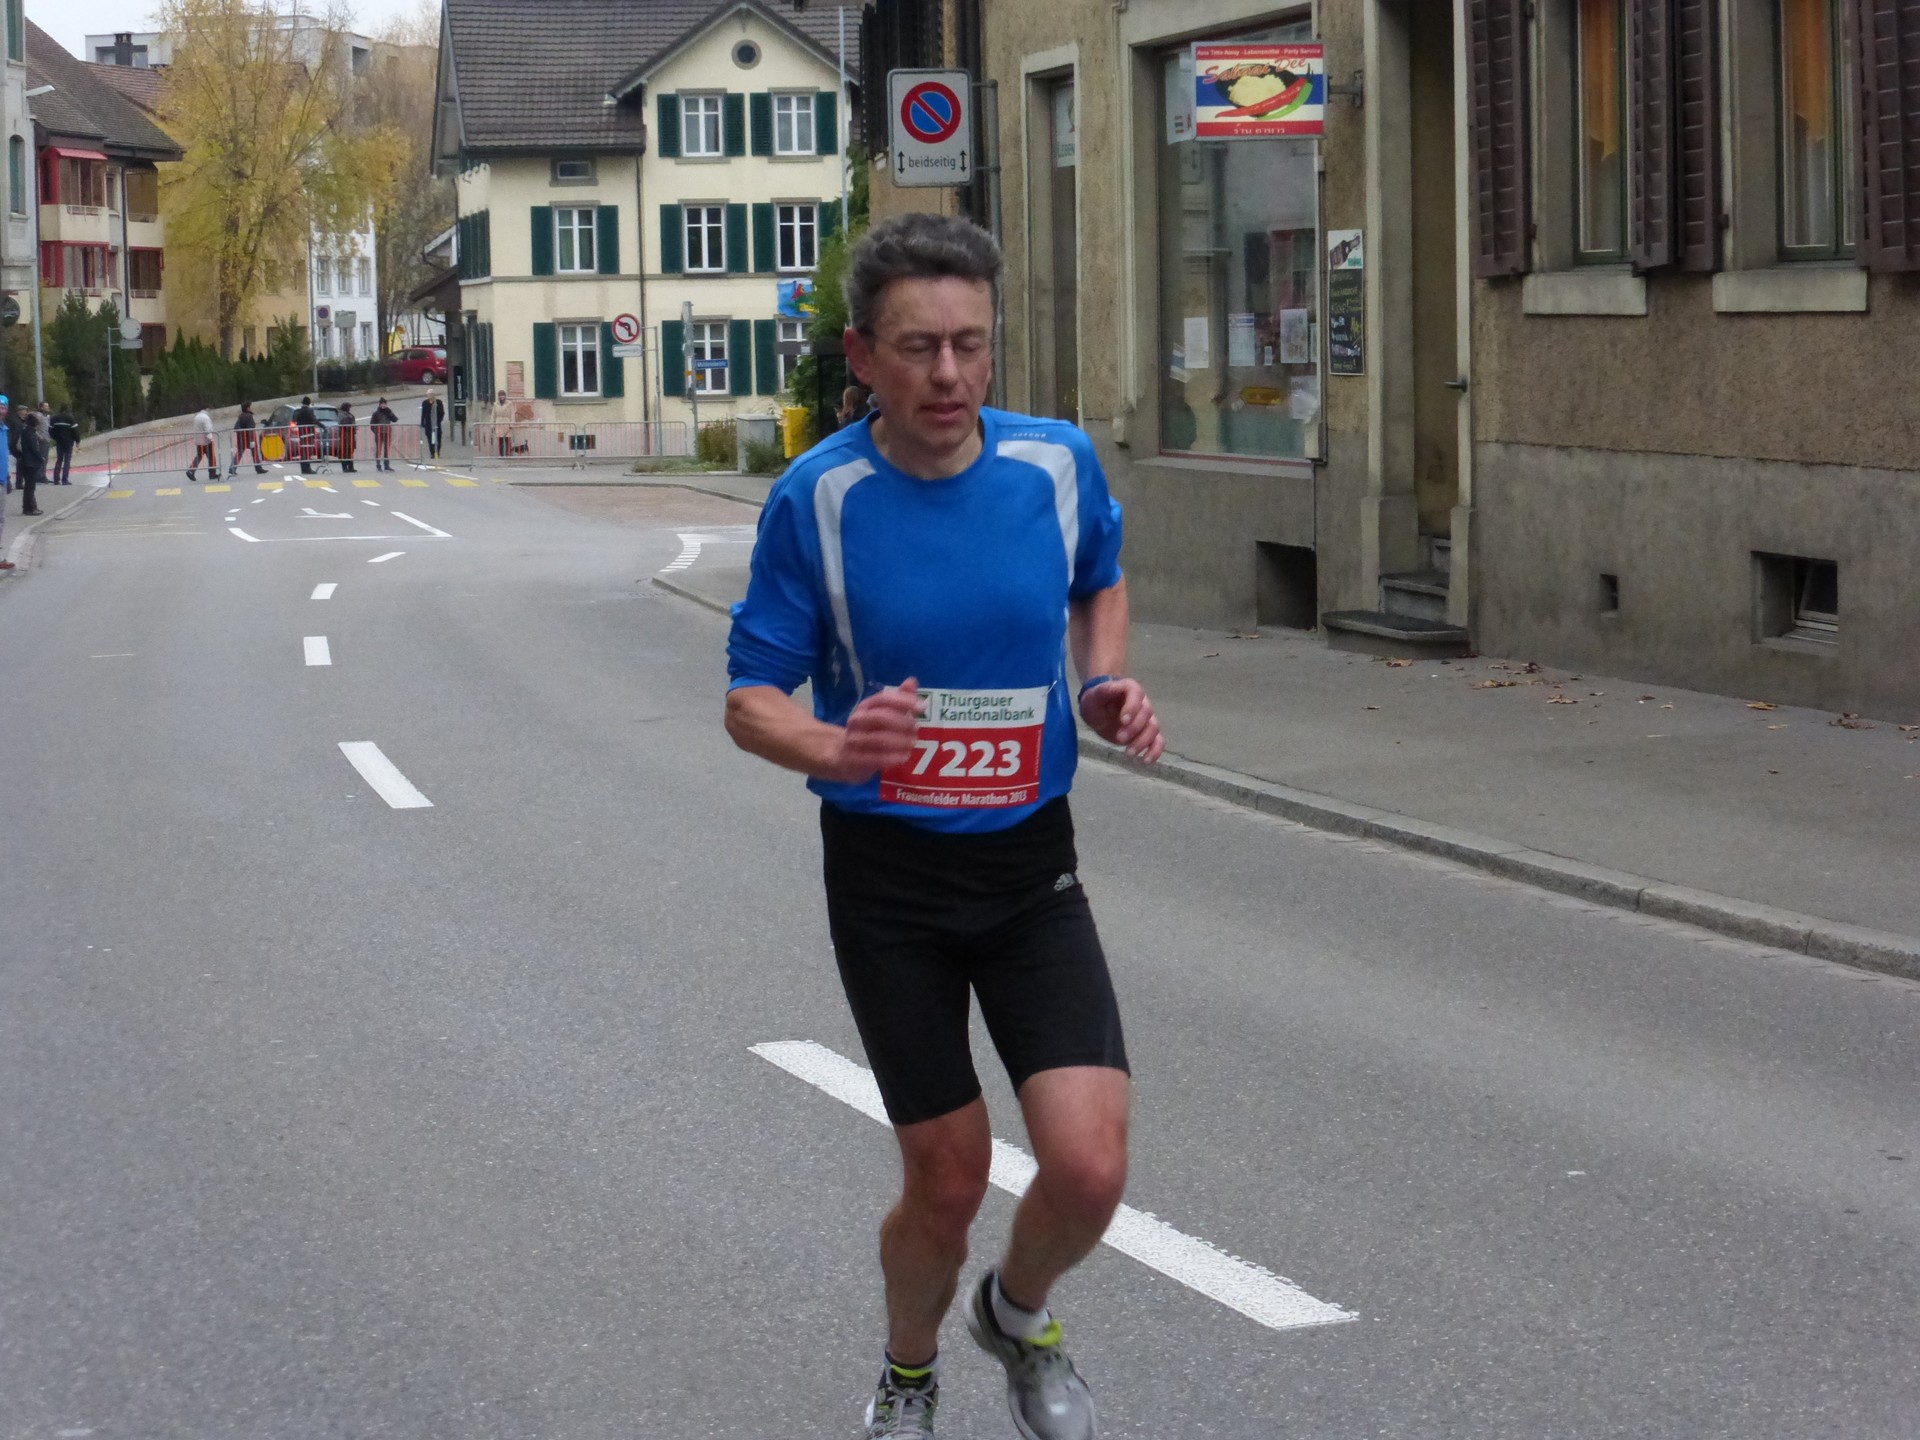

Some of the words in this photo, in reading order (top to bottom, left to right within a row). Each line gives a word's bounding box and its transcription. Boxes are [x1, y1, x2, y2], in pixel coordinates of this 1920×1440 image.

[1274, 57, 1306, 72] Dee
[908, 155, 956, 170] beidseitig
[939, 693, 1014, 710] Thurgauer
[939, 706, 1035, 721] Kantonalbank
[911, 740, 1022, 777] 7223
[896, 788, 960, 806] Frauenfelder
[961, 792, 1008, 805] Marathon
[1008, 789, 1027, 803] 2013
